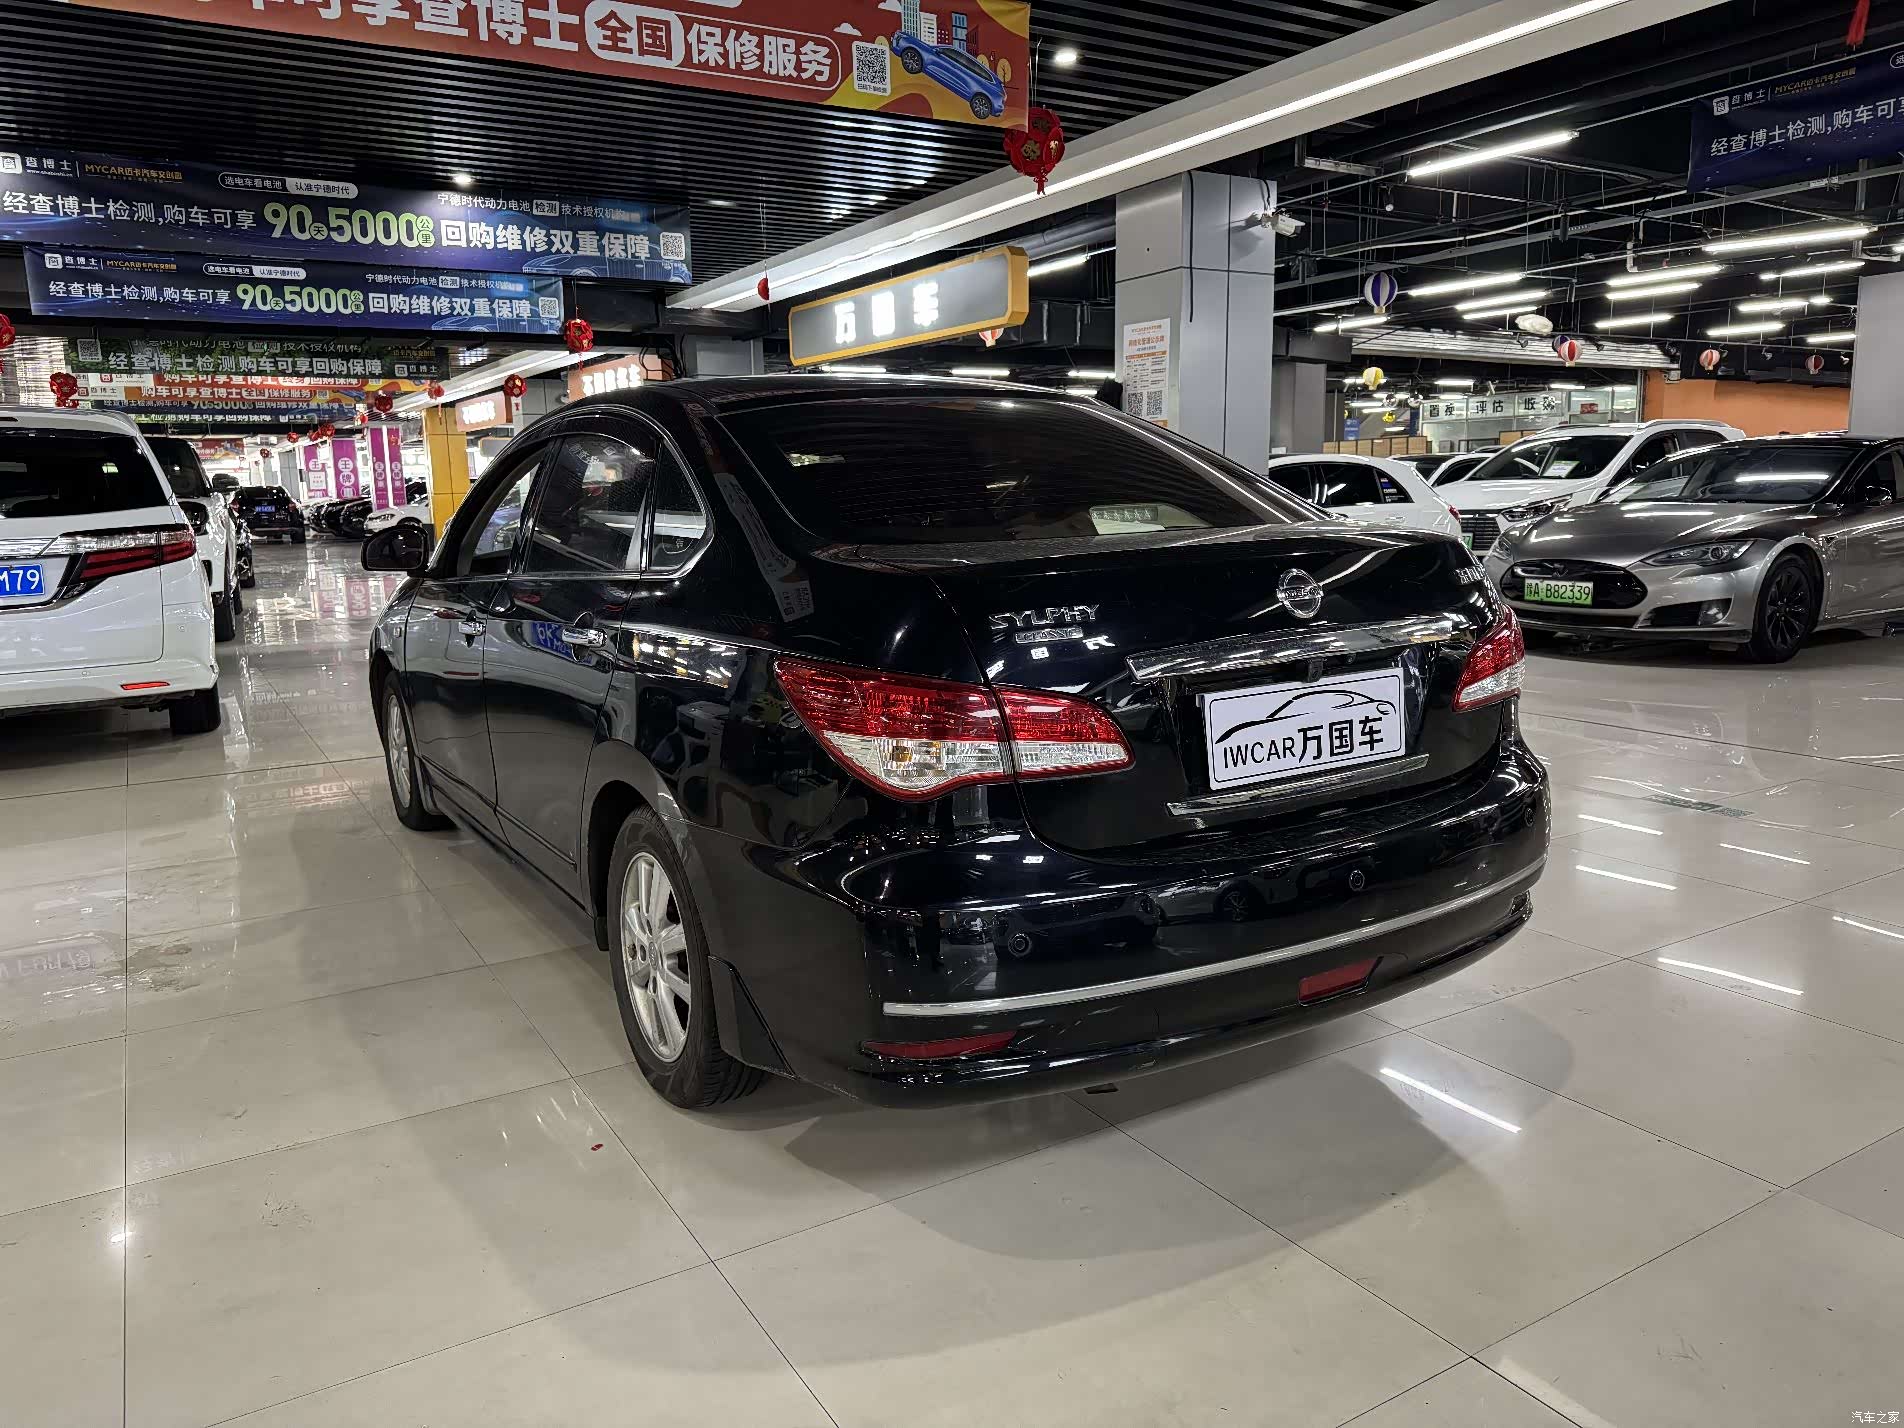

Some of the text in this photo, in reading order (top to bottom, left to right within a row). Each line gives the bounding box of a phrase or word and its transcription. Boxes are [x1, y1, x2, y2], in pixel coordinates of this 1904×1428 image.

[593, 8, 674, 62] 全国
[687, 22, 833, 83] 保修服务
[1710, 96, 1904, 157] 经查博士检测,购车可
[25, 156, 72, 171] 查博士
[224, 175, 351, 195] 选电车看电池 认准宁德时代
[437, 193, 531, 213] 宁德时代动力电池
[3, 190, 257, 230] 经查博士检测,购车可享
[440, 218, 650, 260] 回购维修双重保障
[49, 280, 232, 304] 经查博士检测,购车可享
[368, 292, 532, 319] 回购维修双重保障
[108, 352, 383, 376] 经查博士检测购车可享回购保障
[988, 604, 1100, 630] SYLPHY
